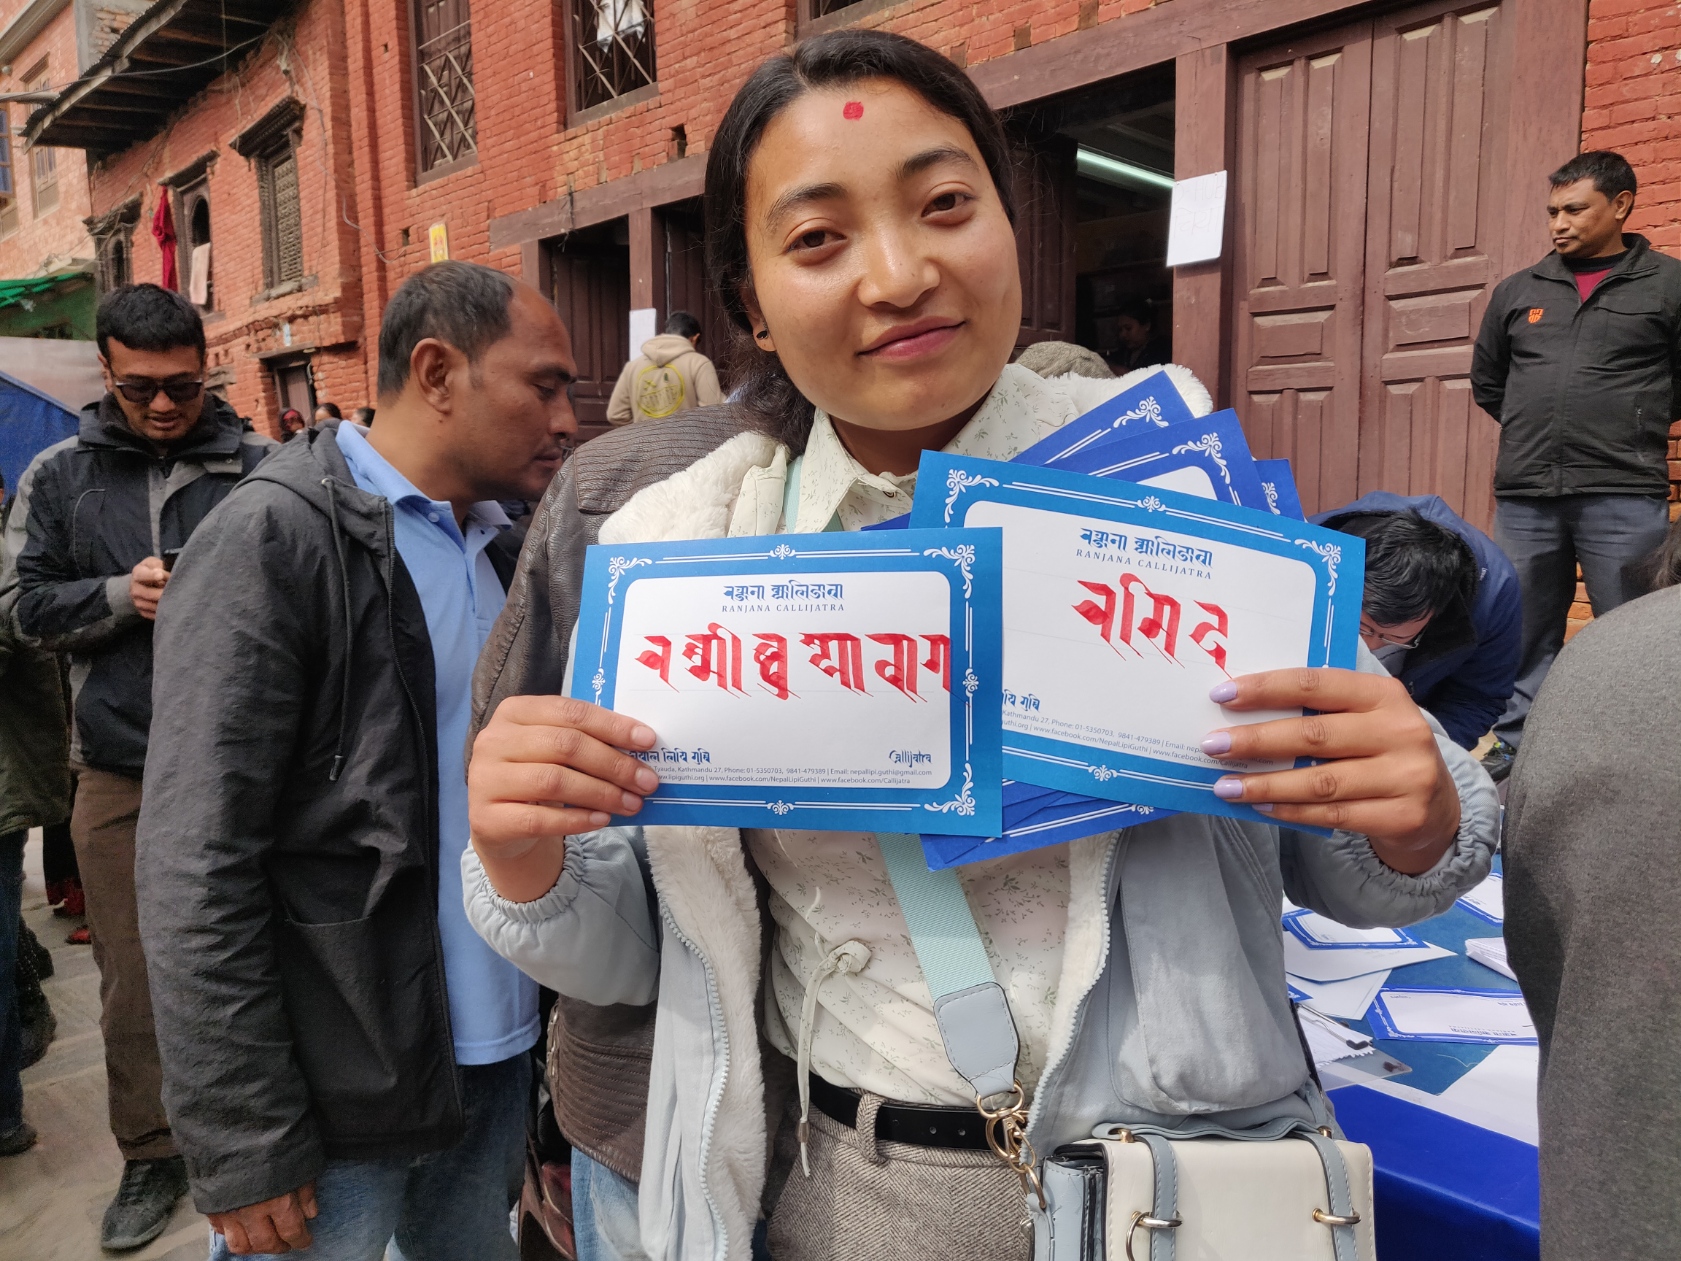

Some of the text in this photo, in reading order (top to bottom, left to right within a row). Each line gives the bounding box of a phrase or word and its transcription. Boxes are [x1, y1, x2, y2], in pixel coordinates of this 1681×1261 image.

[1076, 549, 1212, 580] RANJANA CALLIJATRA
[721, 603, 845, 613] RANJANA CALLIJATRA
[1002, 709, 1040, 722] Kathmandu
[1051, 719, 1074, 729] Phone:
[1117, 731, 1161, 745] 9841-479389
[1165, 740, 1186, 750] Email:
[1033, 725, 1149, 753] www.facebook.com/NepalLipiGuthi
[1152, 748, 1248, 769] www.facebook.com/Callijatra
[889, 749, 933, 768] Callijatra
[709, 775, 817, 784] www.facebook.com/NepalLipiGuthi
[820, 777, 911, 785] www.facebook.com/Callijatra
[849, 768, 932, 777] nepallipi.guthi@gmail.com
